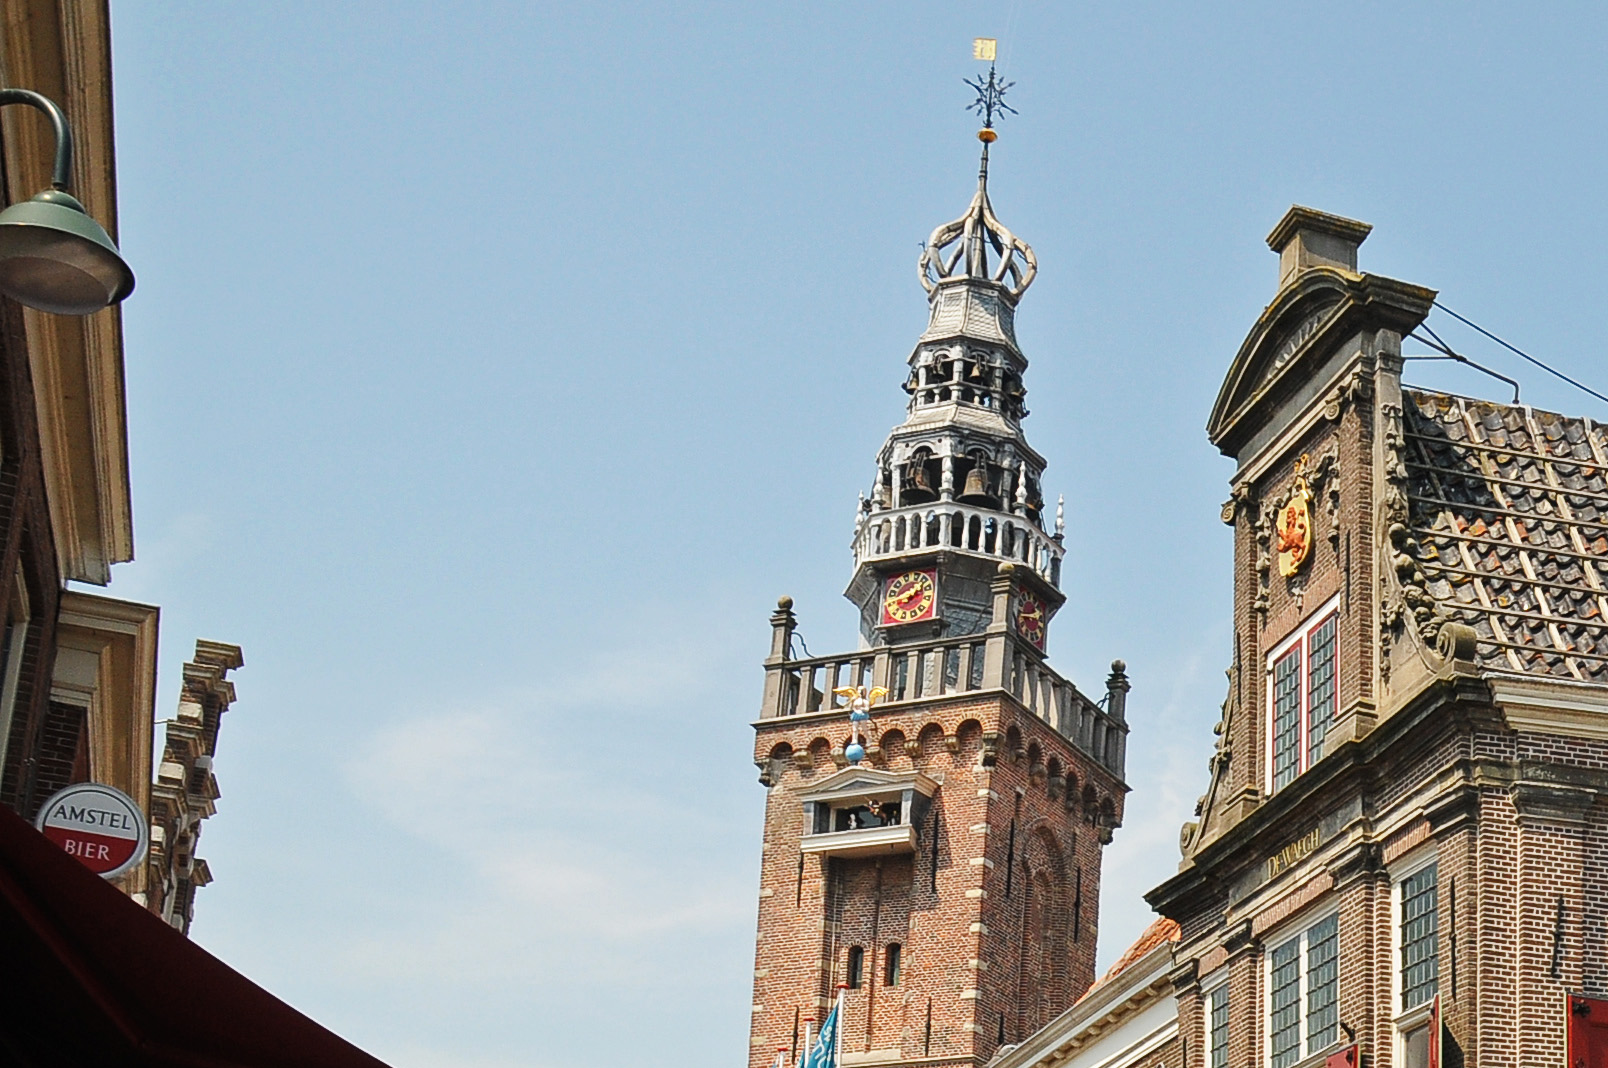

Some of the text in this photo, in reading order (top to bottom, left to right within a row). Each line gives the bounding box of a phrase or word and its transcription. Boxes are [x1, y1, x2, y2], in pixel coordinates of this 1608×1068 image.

[53, 804, 131, 830] AMSTEL
[64, 839, 110, 861] BIER
[1281, 828, 1321, 867] WAEGH
